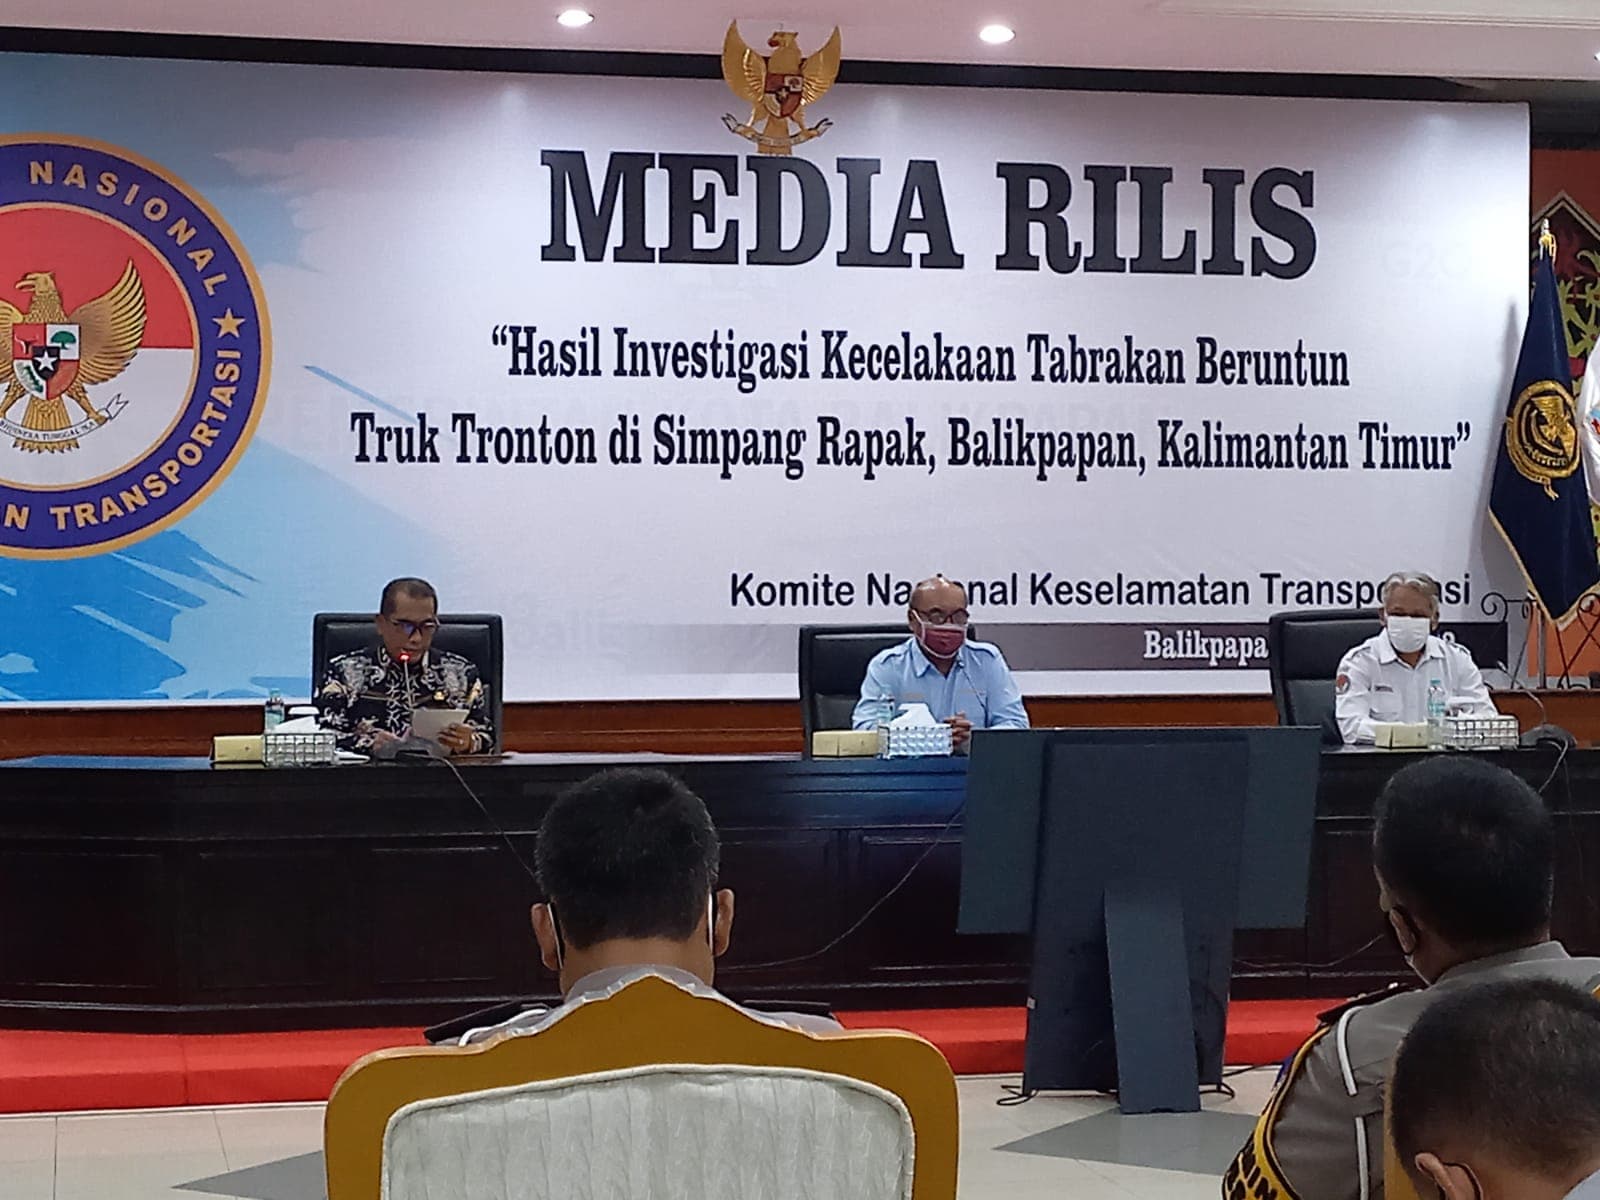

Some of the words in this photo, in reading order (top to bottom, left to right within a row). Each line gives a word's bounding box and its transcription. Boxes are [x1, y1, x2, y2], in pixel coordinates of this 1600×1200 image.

[29, 160, 228, 297] NASIONAL
[541, 150, 964, 269] MEDIA
[996, 162, 1316, 279] RILIS
[493, 324, 602, 377] “Hasil
[613, 327, 810, 394] Investigasi
[821, 330, 1017, 382] Kecelakaan
[1026, 333, 1186, 385] Tabrakan
[1195, 336, 1350, 387] Beruntun
[49, 350, 242, 531] TRANSPORTASI
[350, 412, 440, 464] Truk
[451, 412, 598, 465] Tronton
[609, 414, 642, 465] di
[653, 413, 807, 481] Simpang
[816, 416, 936, 481] Rapak,
[947, 417, 1146, 482] Balikpapan,
[1157, 419, 1349, 470] Kalimantan
[1358, 421, 1471, 471] Timur”
[731, 572, 855, 607] Komite
[867, 572, 1018, 607] Nanal
[1030, 572, 1249, 606] Keselamatan
[1143, 629, 1270, 667] Balikpapa
